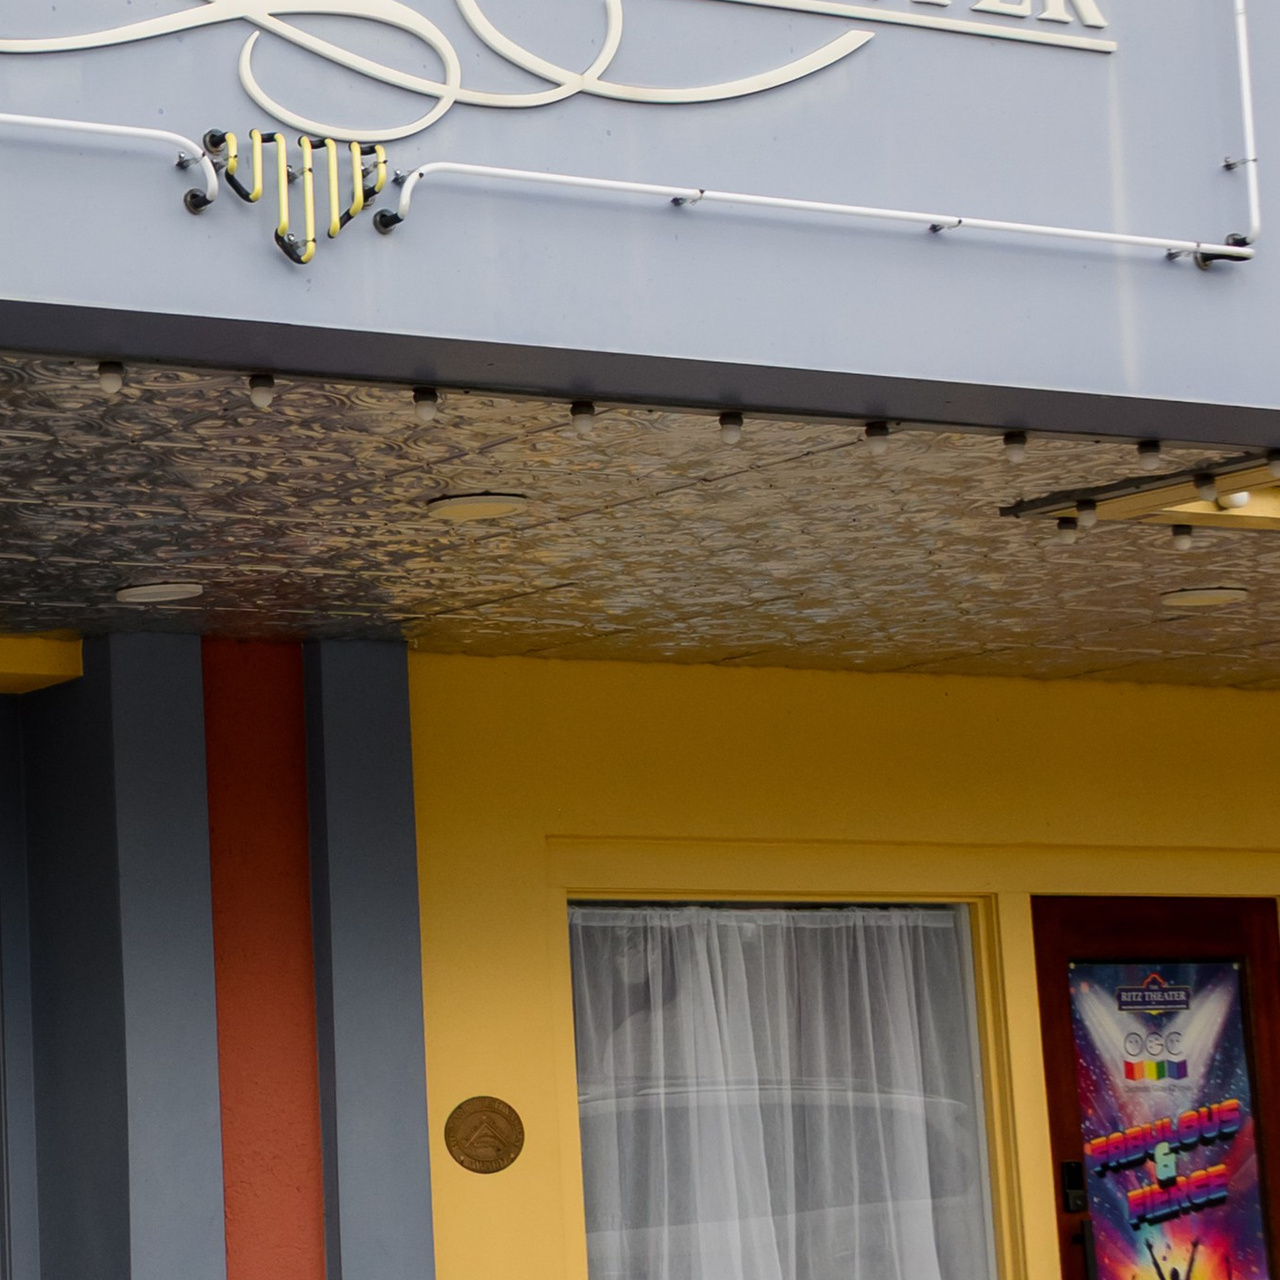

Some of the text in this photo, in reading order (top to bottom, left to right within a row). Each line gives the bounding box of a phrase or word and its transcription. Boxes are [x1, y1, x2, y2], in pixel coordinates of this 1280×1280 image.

[1120, 990, 1188, 1002] RITZ THEATER
[1123, 1030, 1183, 1057] OGC
[1090, 1098, 1241, 1174] FABULOUS
[1127, 1163, 1229, 1229] FIERCE
